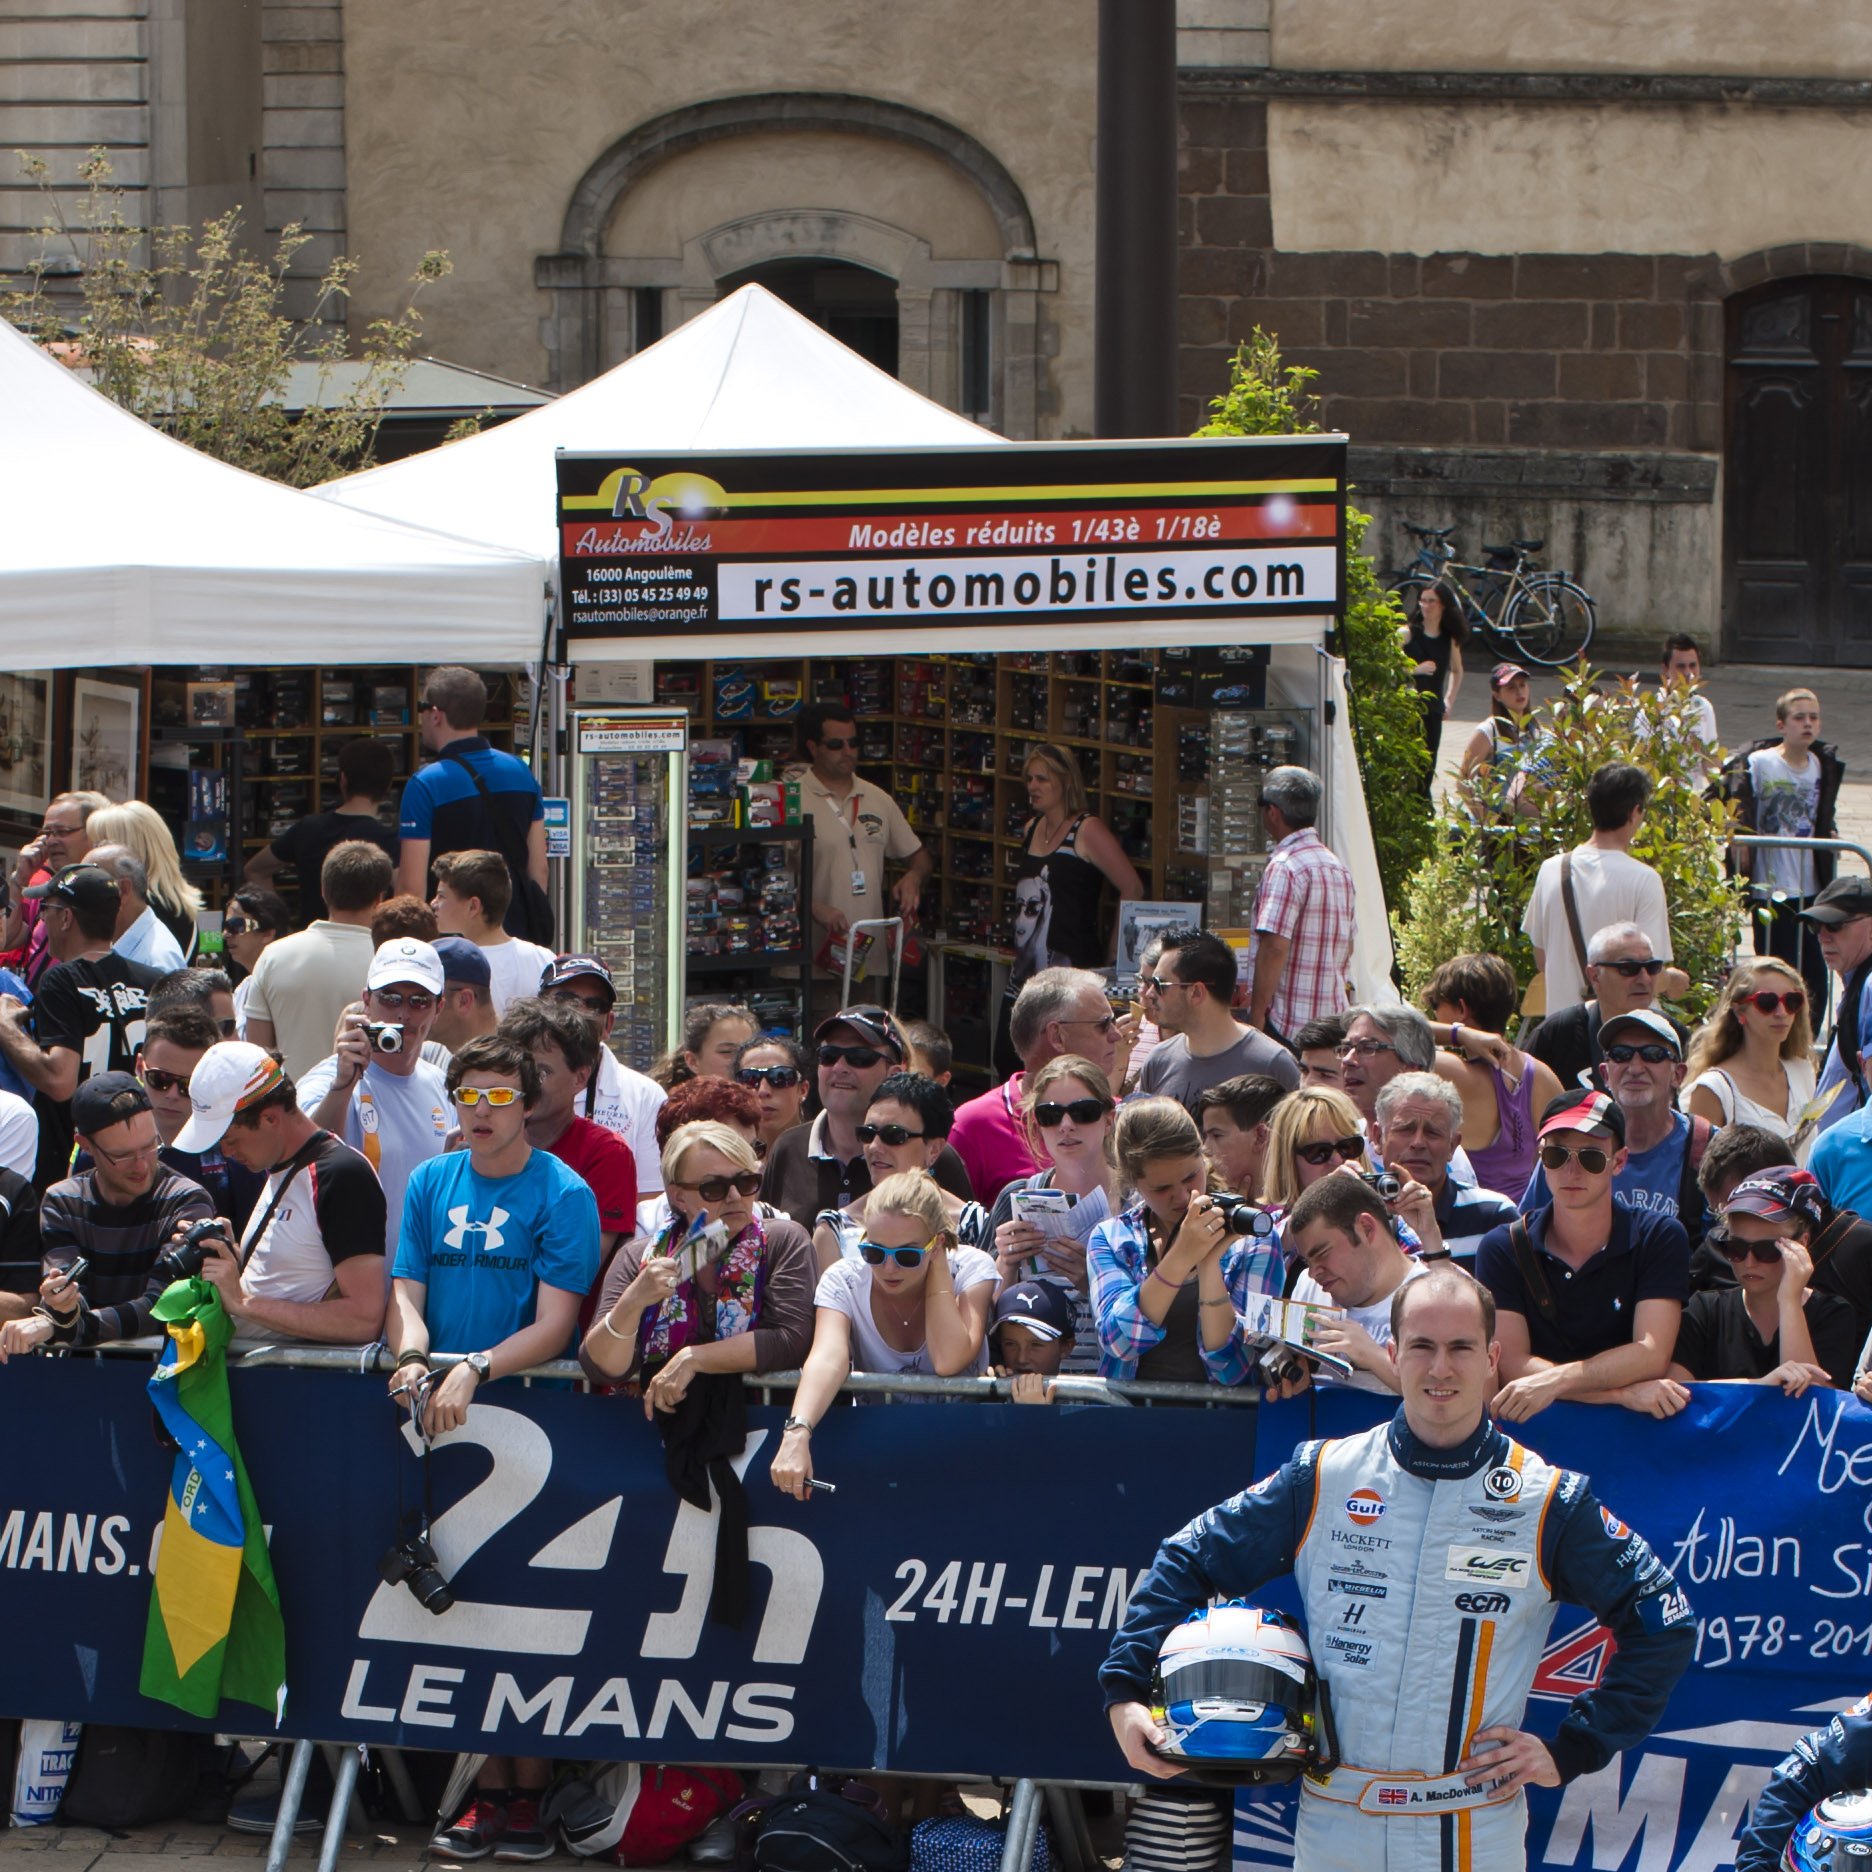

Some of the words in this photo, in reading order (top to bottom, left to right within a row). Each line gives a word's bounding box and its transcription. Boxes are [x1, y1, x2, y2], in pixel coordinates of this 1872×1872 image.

[576, 524, 713, 555] Automobiles
[848, 521, 956, 549] Modèles
[966, 517, 1056, 546] réduits
[1071, 515, 1141, 544] 1/43è
[1155, 513, 1223, 542] 1/18è
[586, 567, 623, 583] 16000
[625, 565, 693, 584] Angoulême
[754, 555, 1307, 612] rs-automobiles.com
[599, 588, 623, 606] (33)
[624, 587, 639, 603] 05
[641, 587, 657, 602] 45
[658, 586, 674, 601] 25
[676, 585, 691, 601] 49
[693, 584, 709, 600] 49
[573, 603, 709, 625] rsautomobiles@orange.fr
[1345, 1497, 1387, 1518] Gulf
[359, 1402, 825, 1664] 24h
[1331, 1529, 1393, 1551] HACKETT
[1343, 1543, 1375, 1553] LONDON
[1466, 1554, 1528, 1575] WEC
[1343, 1583, 1386, 1597] MICHELIN
[1454, 1591, 1512, 1614] ecm
[1329, 1635, 1373, 1656] Hanergy
[1343, 1652, 1371, 1667] Solar
[341, 1659, 466, 1728] LE
[481, 1672, 795, 1745] MANS
[1410, 1789, 1423, 1803] A.
[1425, 1783, 1483, 1803] MacDowall
